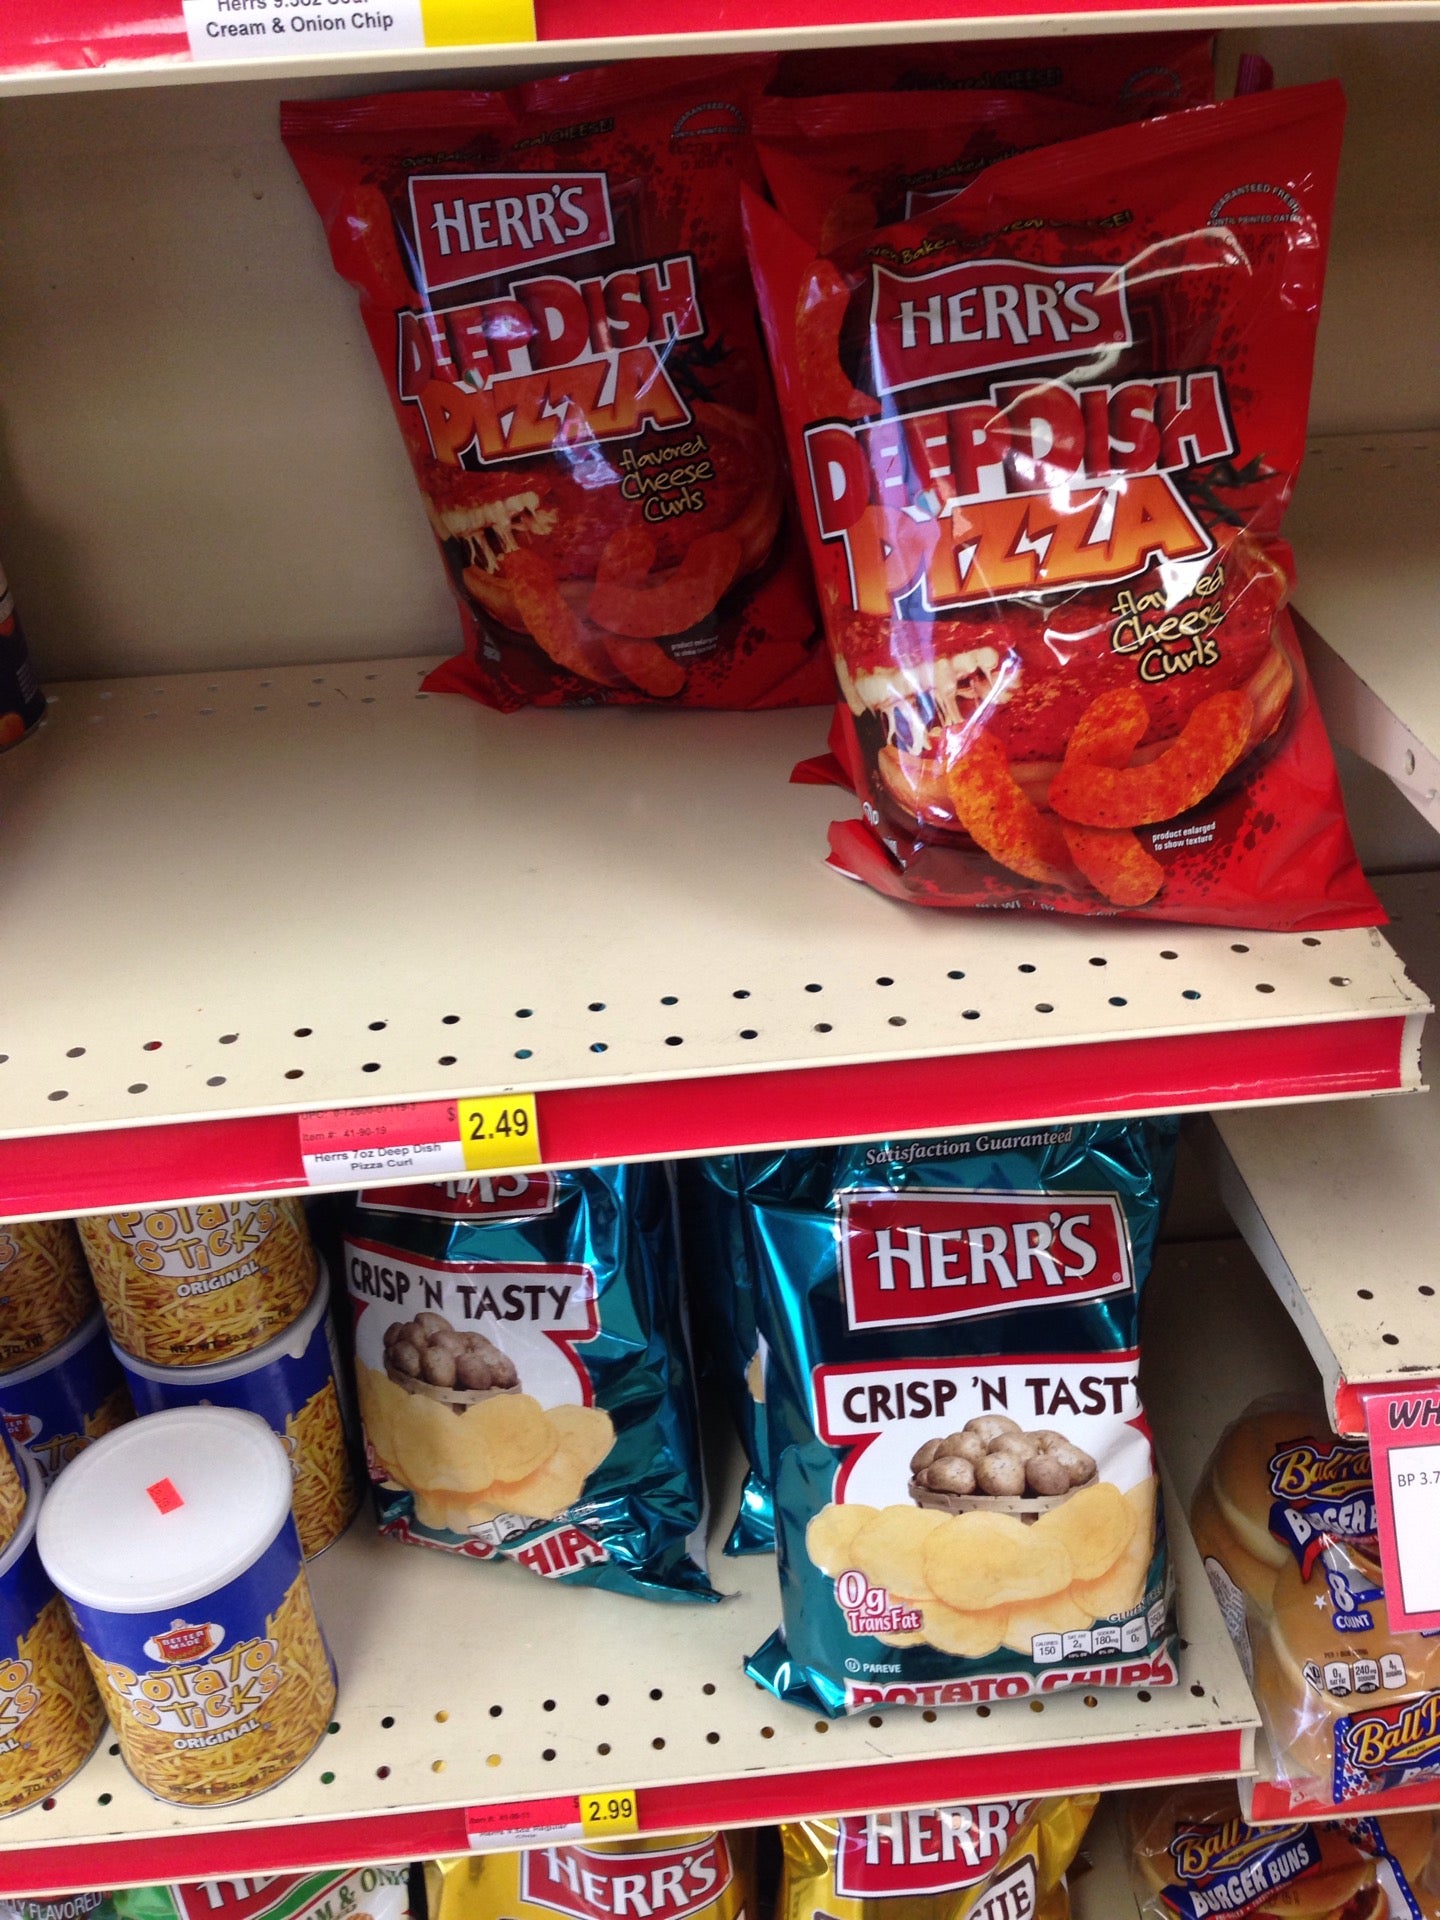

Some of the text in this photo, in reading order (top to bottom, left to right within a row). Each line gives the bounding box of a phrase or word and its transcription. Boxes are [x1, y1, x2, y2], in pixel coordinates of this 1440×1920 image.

[206, 12, 394, 37] Cream & Onion Chip
[1210, 183, 1271, 219] GUARANTEED
[430, 185, 591, 257] HERR'S
[894, 280, 1102, 350] HERR'S
[408, 347, 692, 468] PIZZA
[619, 434, 708, 470] flavored
[621, 461, 714, 499] Cheese
[644, 487, 704, 521] Curls
[847, 474, 1214, 617] PIZZA
[1111, 566, 1225, 615] flaved
[1112, 600, 1223, 654] Cheese
[1140, 635, 1219, 682] Curls
[1152, 821, 1216, 844] product enlarged
[1154, 834, 1213, 851] to show texture
[447, 1107, 456, 1121] $
[468, 1107, 529, 1141] 2.49
[314, 1143, 442, 1163] Herrs 7oz Deep Dish
[350, 1157, 413, 1171] Pizza Curl
[865, 1126, 1074, 1166] Satisfaction Guaranteed
[867, 1211, 1098, 1291] HERR'S
[176, 1258, 260, 1299] ORIGINAL
[351, 1256, 573, 1322] CRISP 'N TASTY
[842, 1378, 958, 1424] CRISP
[971, 1375, 1007, 1411] 'N
[1397, 1470, 1440, 1488] BP 3.7
[838, 1570, 886, 1616] 0g
[1328, 1572, 1355, 1613] 8
[162, 1630, 204, 1645] BETTER
[169, 1638, 200, 1650] MADE
[1039, 1646, 1056, 1656] 150
[863, 1663, 902, 1674] PAREVE
[172, 1718, 260, 1751] ORIGINAL
[1352, 1708, 1424, 1764] Ball
[589, 1798, 632, 1822] 2.99
[1175, 1818, 1242, 1873] Ball
[339, 1885, 356, 1910] &
[540, 1847, 718, 1918] HERR'S
[1188, 1860, 1269, 1919] BURGER
[1267, 1842, 1310, 1885] BUNS
[29, 1891, 103, 1920] FLAVORED
